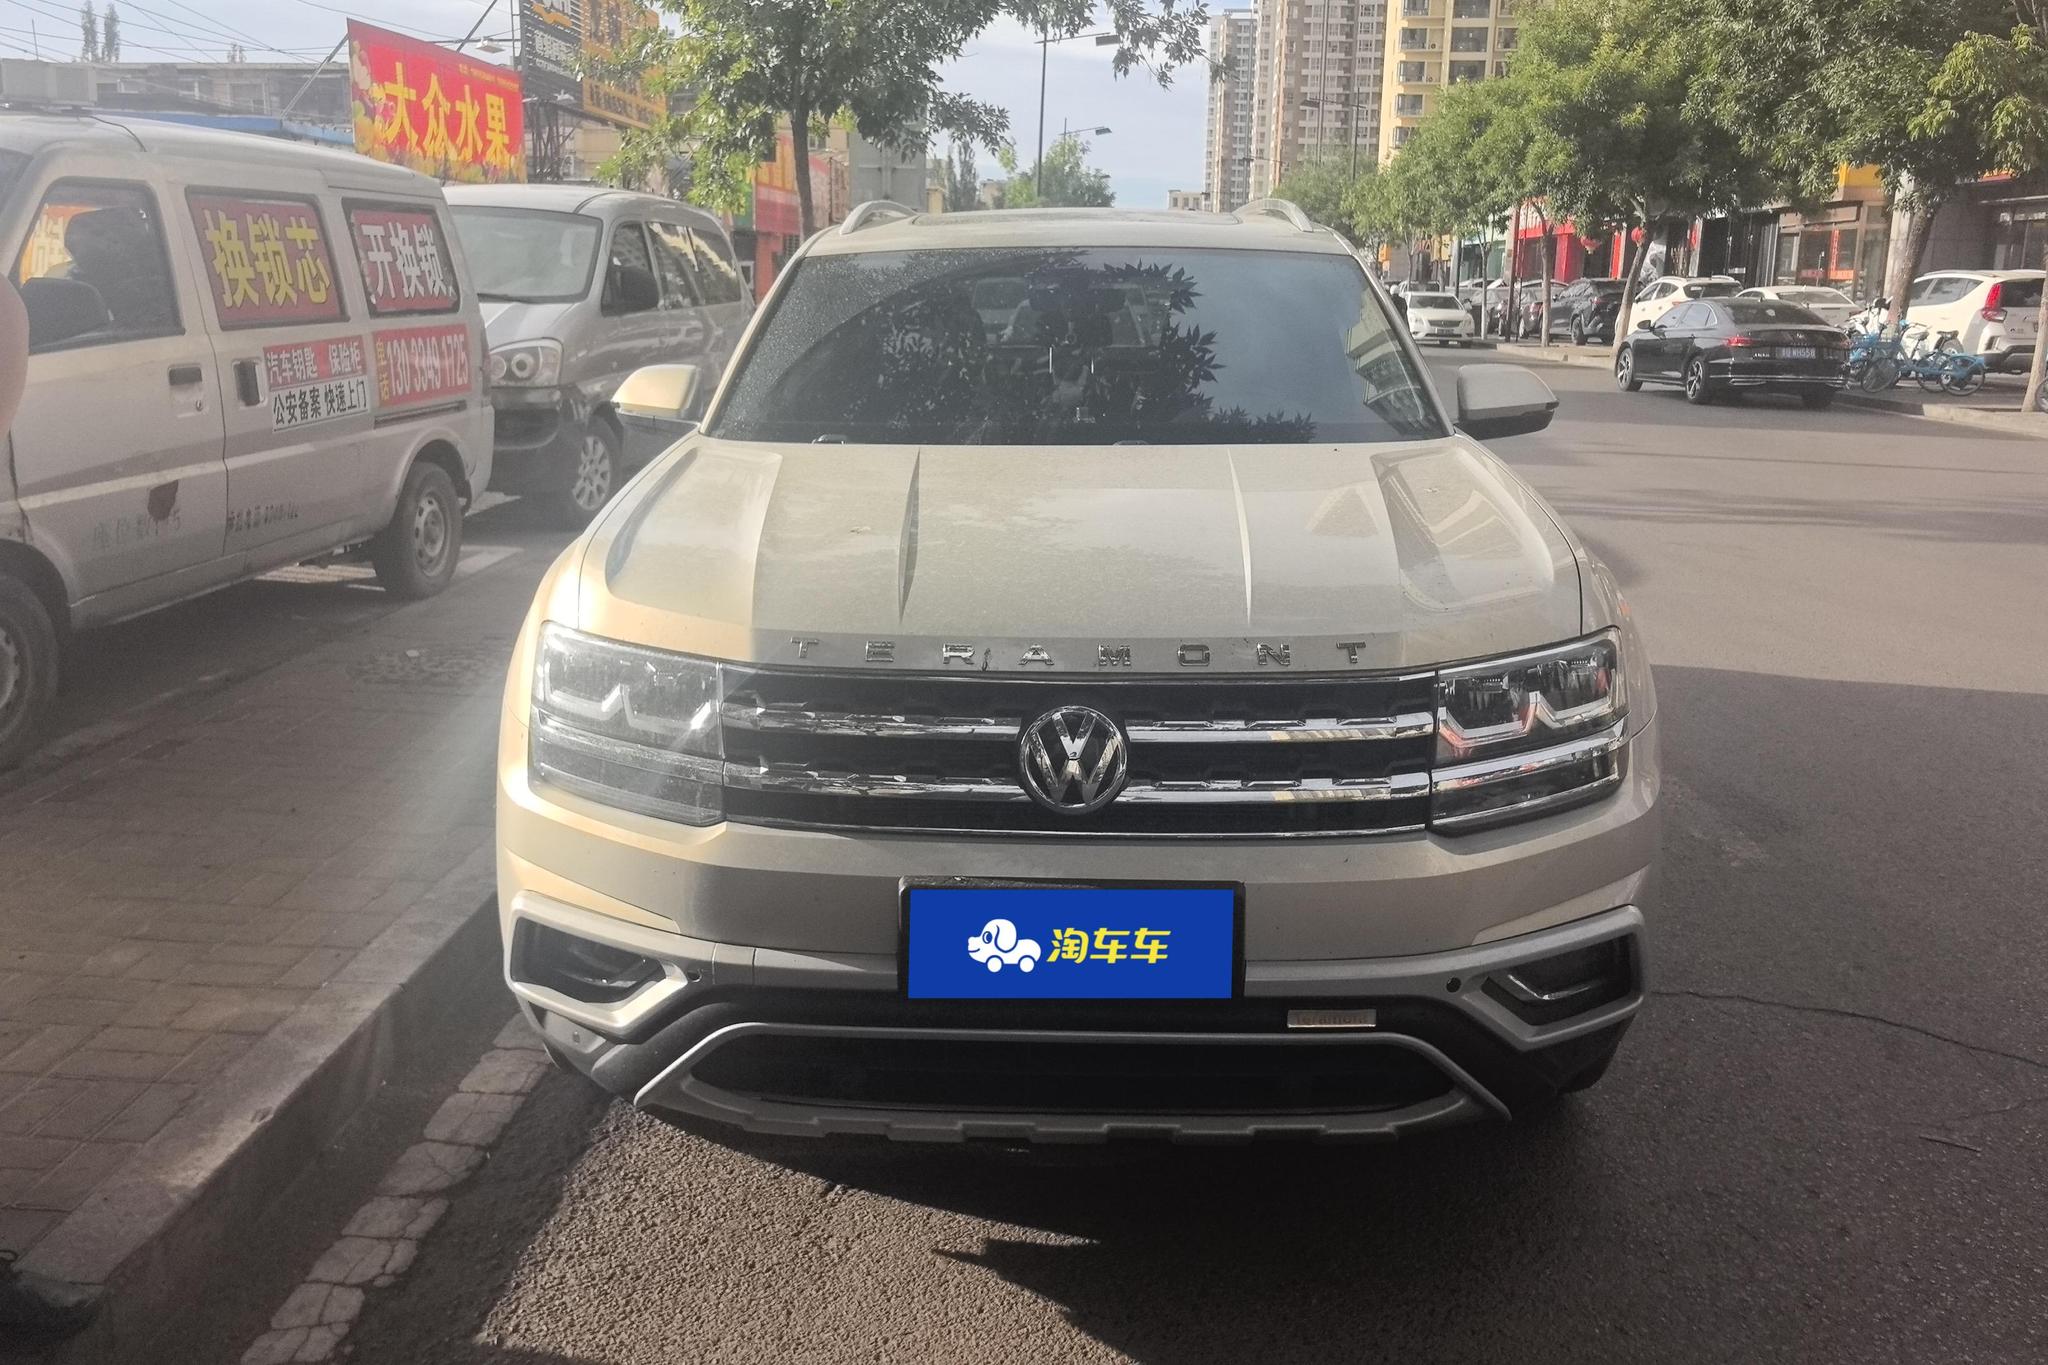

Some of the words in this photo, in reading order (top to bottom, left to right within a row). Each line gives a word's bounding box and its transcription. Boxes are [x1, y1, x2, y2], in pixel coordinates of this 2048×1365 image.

[384, 61, 510, 164] 大众水果
[203, 208, 331, 307] 换锁芯
[360, 221, 449, 298] 开换锁
[266, 346, 318, 384] 汽车钥匙
[328, 341, 363, 376] 保险柜
[375, 338, 391, 401] 电话
[273, 386, 322, 425] 公安备案
[324, 379, 368, 416] 快速上门
[790, 636, 1367, 667] TERAMONT
